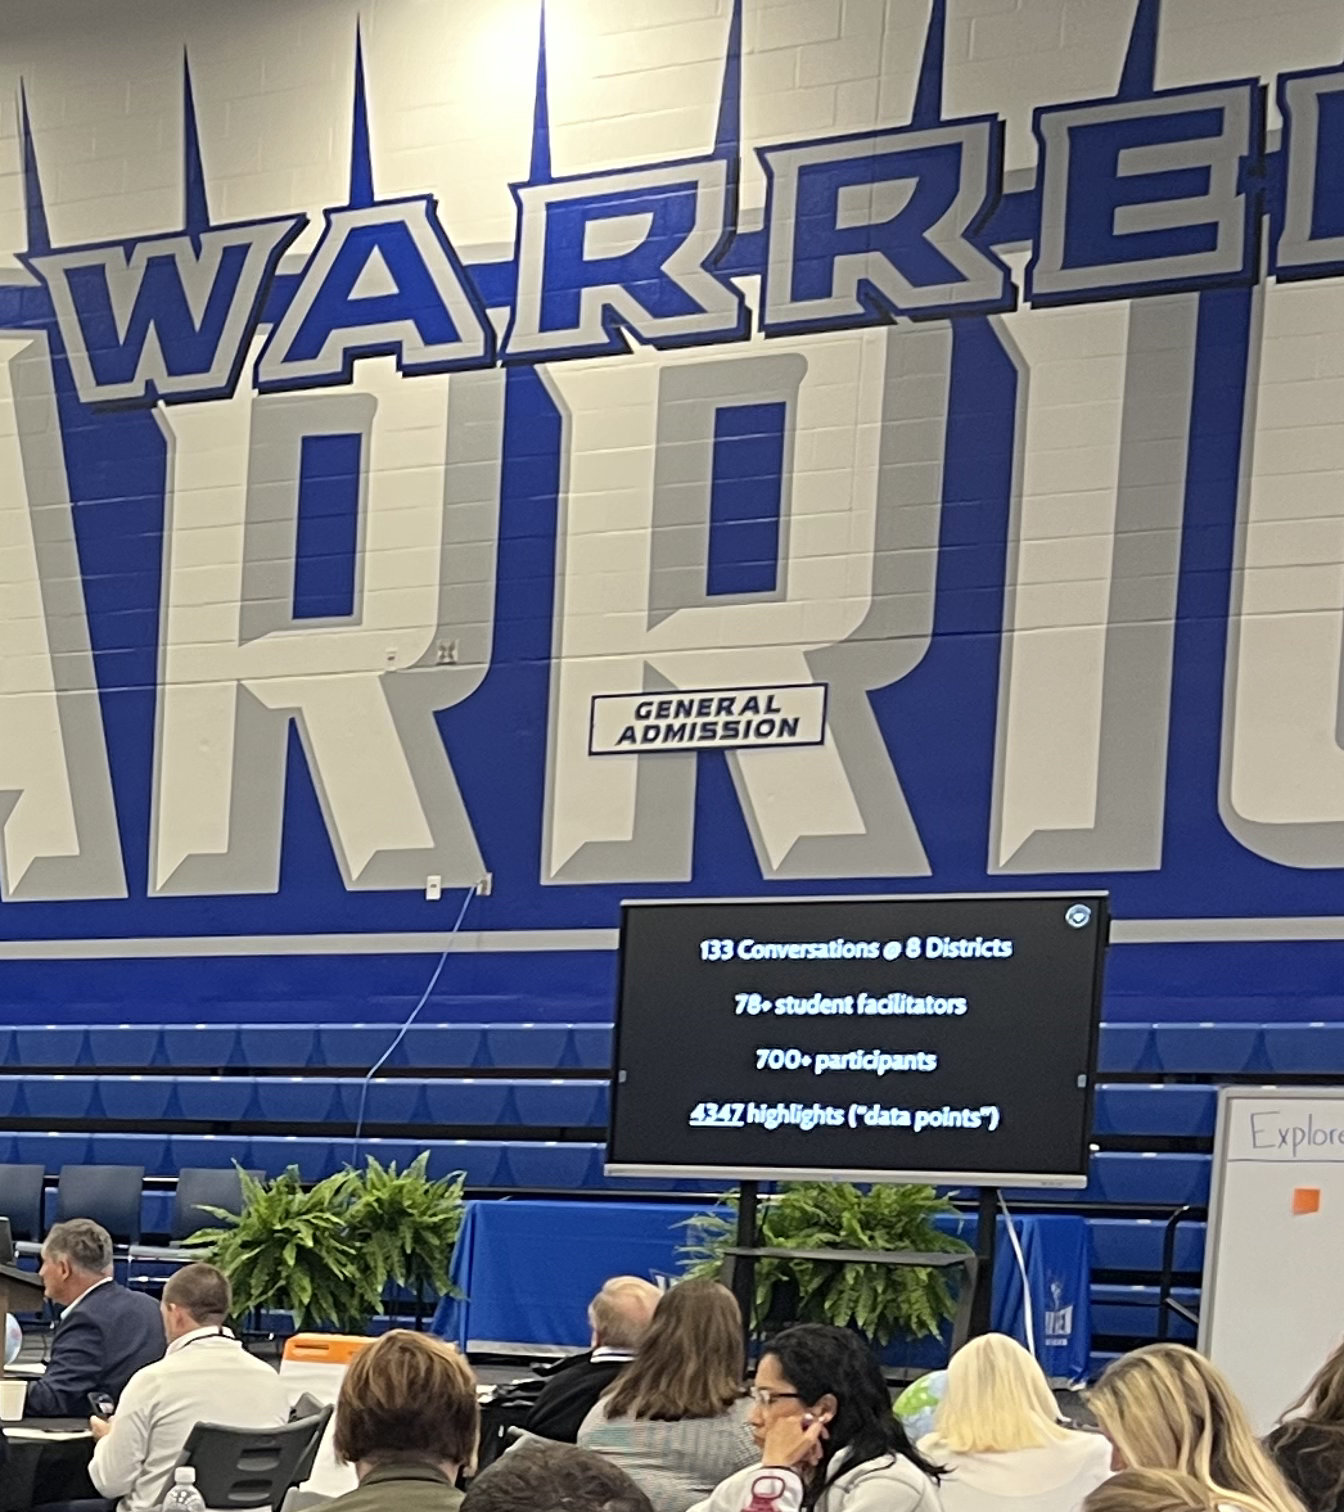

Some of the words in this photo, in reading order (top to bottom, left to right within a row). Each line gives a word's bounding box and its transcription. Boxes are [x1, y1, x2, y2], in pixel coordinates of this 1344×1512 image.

[15, 64, 1344, 410] WARRE
[634, 694, 782, 721] GENERAL
[614, 717, 800, 746] ADMISSION
[700, 939, 733, 961] 133
[737, 938, 880, 961] Conversations
[906, 937, 921, 958] 8
[926, 937, 1013, 960] Districts
[734, 993, 772, 1016] 78+
[775, 994, 854, 1016] student
[857, 994, 967, 1017] facilitators
[756, 1049, 812, 1071] 700+
[814, 1049, 938, 1076] participants
[689, 1103, 744, 1128] 4347
[746, 1102, 845, 1132] highlights
